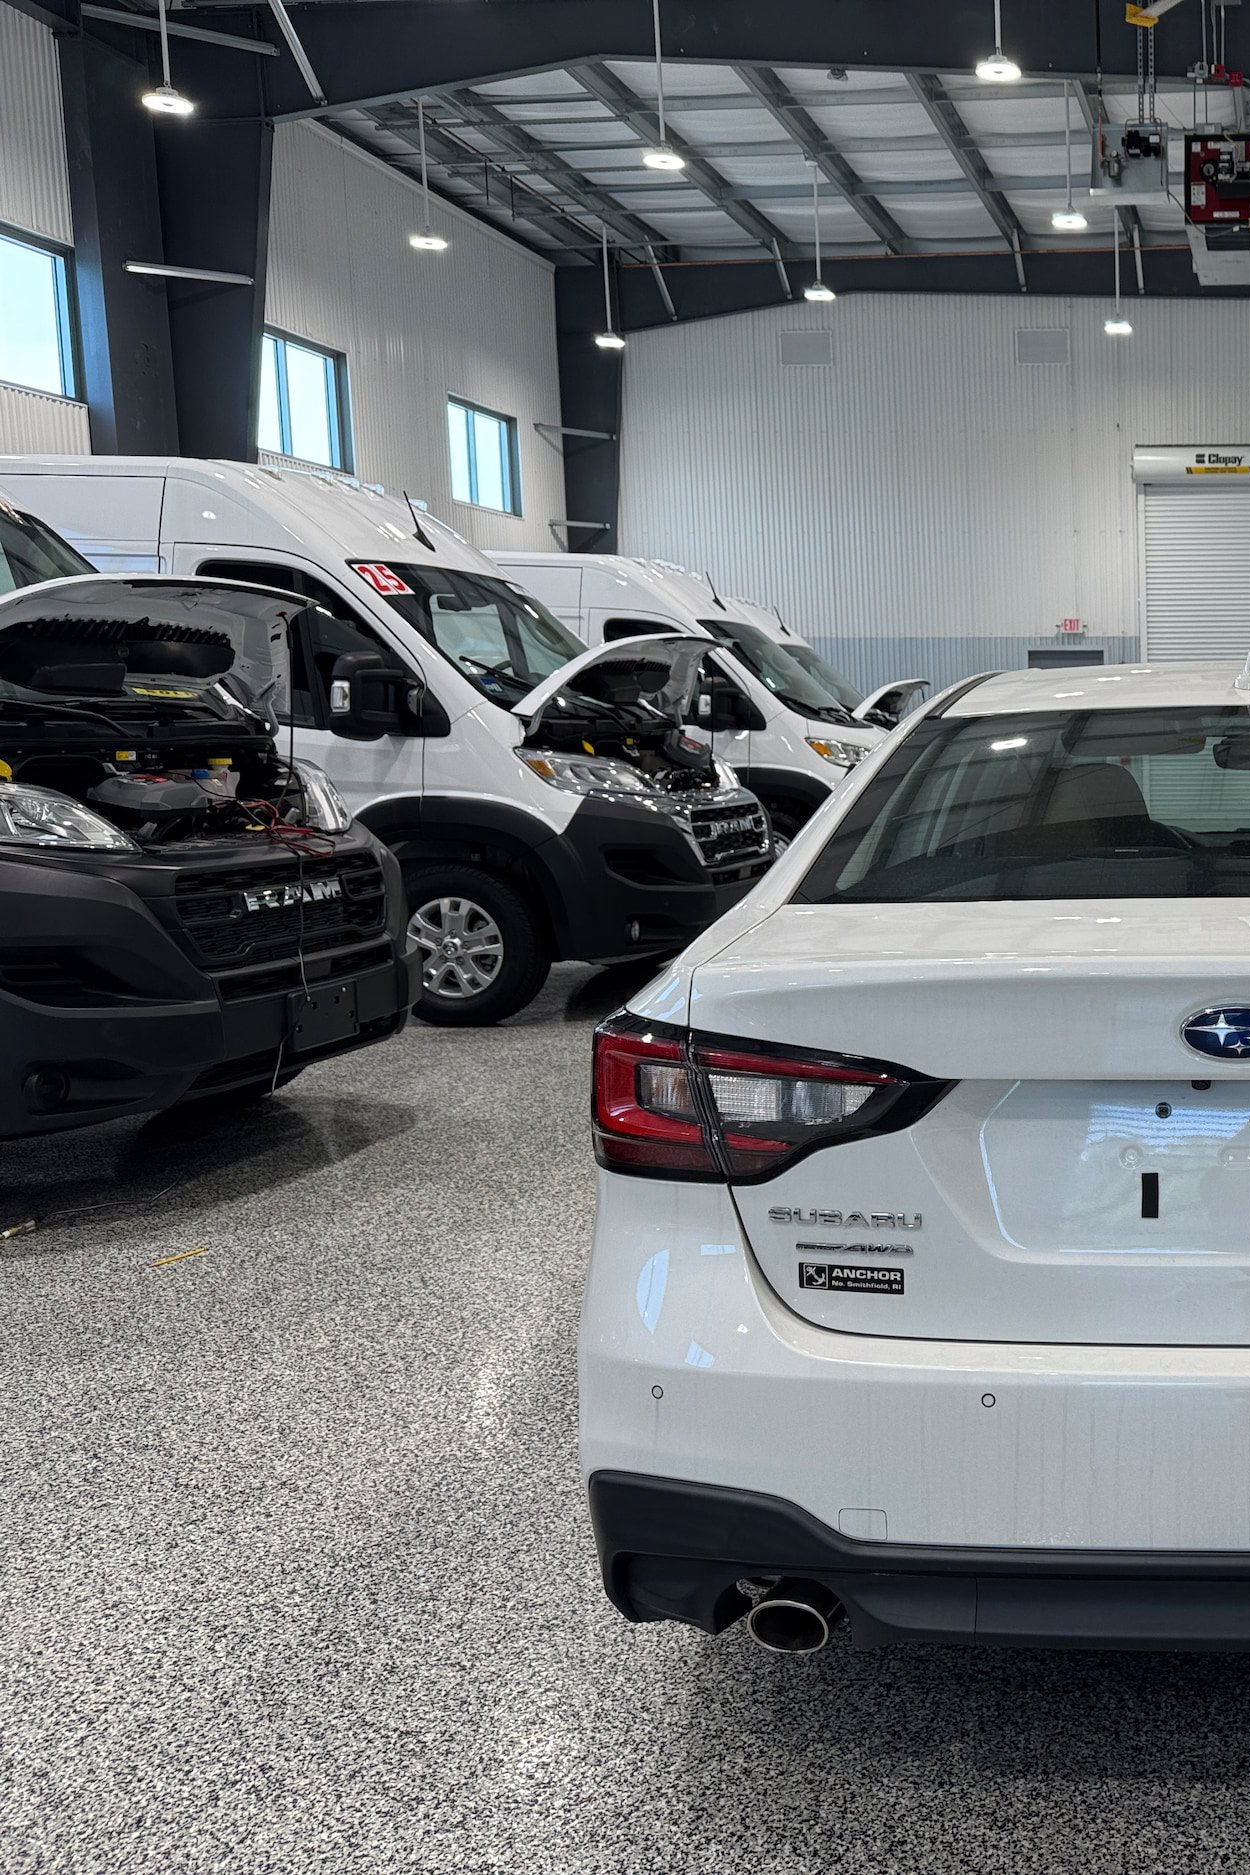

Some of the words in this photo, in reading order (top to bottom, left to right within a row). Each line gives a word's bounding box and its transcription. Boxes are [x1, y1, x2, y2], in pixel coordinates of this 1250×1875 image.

[1208, 453, 1243, 466] Clopay
[357, 566, 406, 592] 25
[1063, 618, 1080, 631] EXIT
[243, 880, 342, 911] RAM
[768, 1206, 922, 1228] SUBARU
[831, 1268, 902, 1281] ANCHOR
[847, 1281, 891, 1290] Smithfield,
